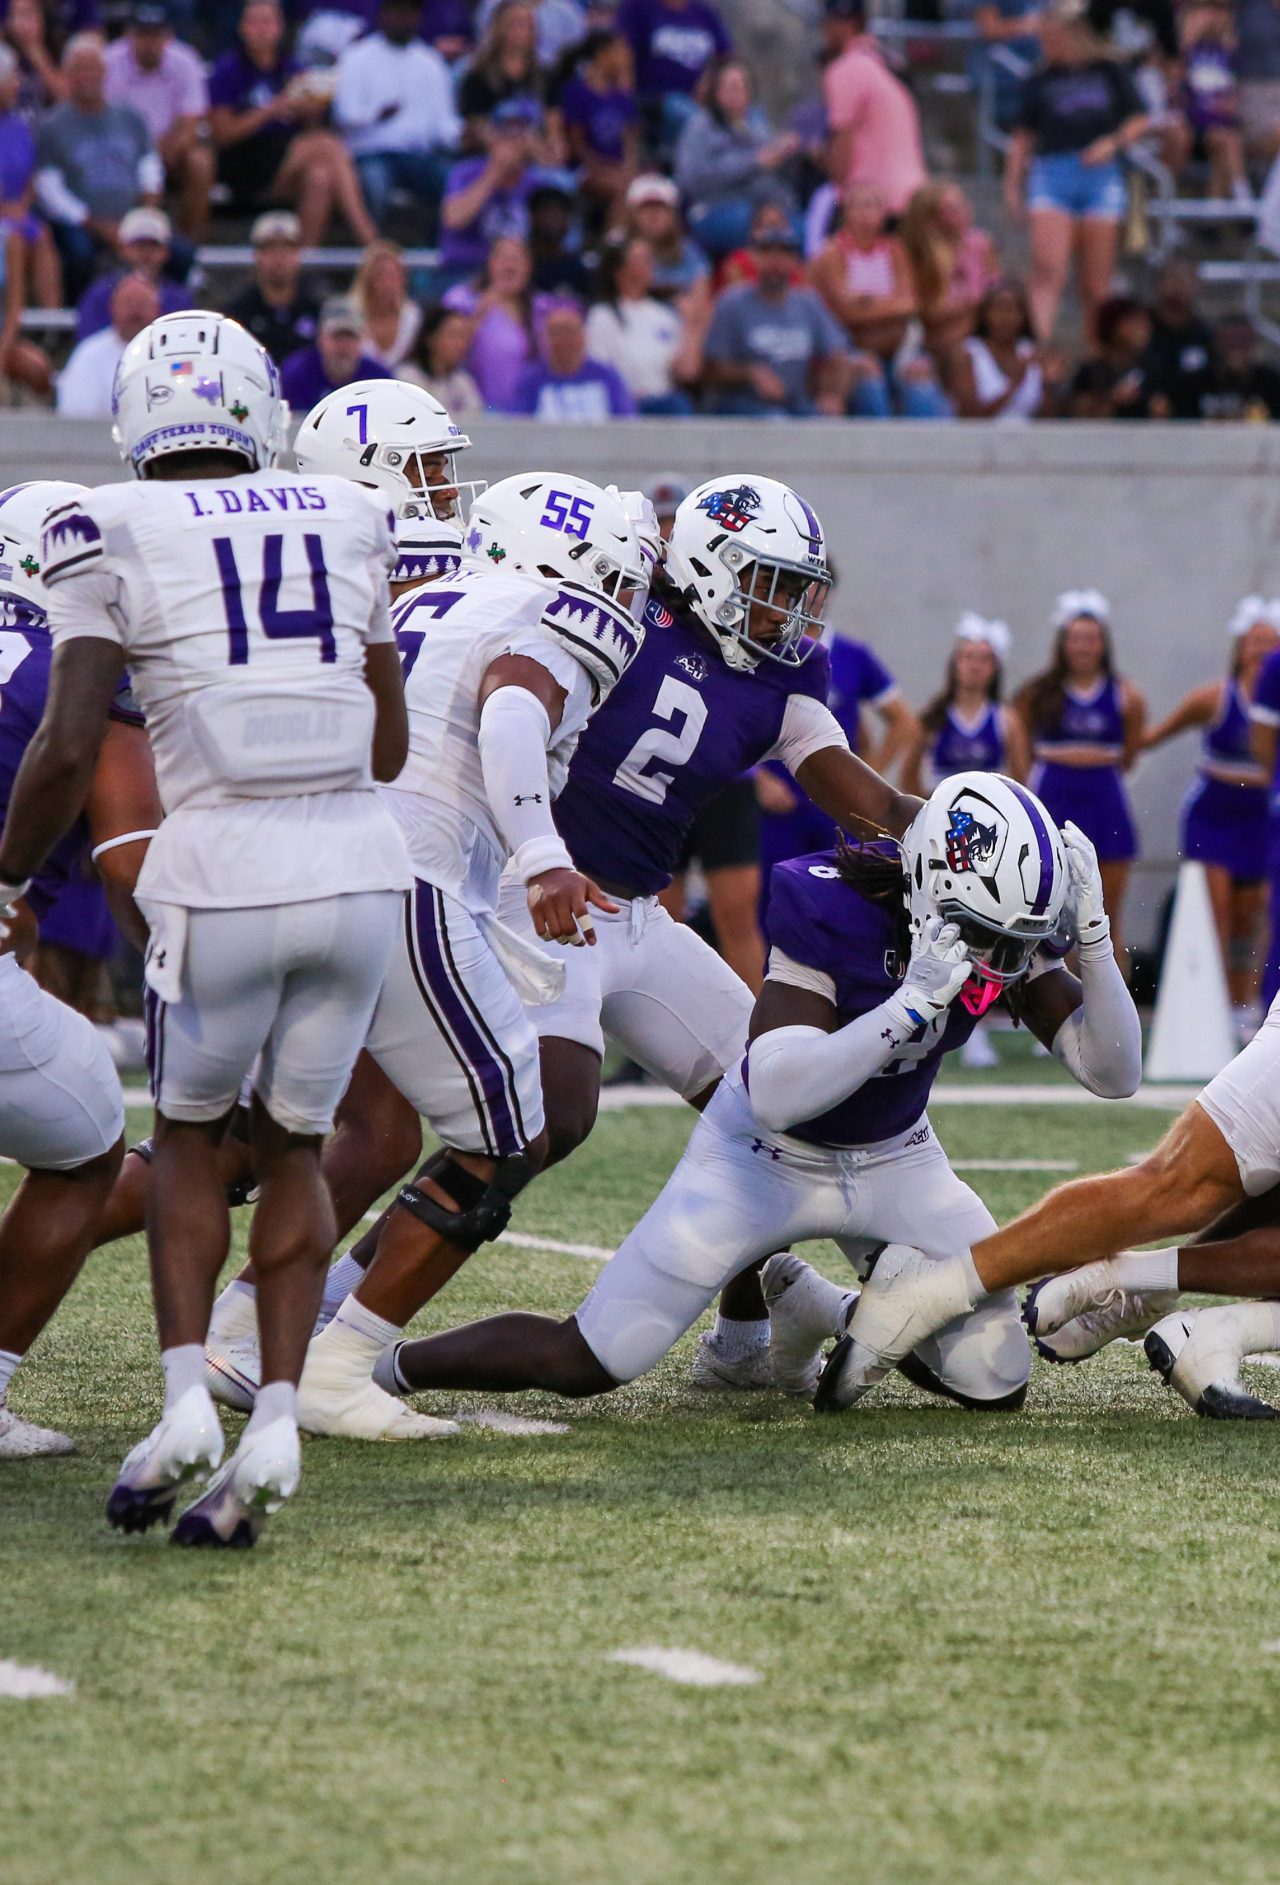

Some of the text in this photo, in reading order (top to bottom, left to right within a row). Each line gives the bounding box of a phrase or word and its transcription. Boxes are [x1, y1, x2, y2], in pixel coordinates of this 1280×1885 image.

[160, 423, 206, 440] TEXAS
[208, 424, 250, 448] TOUGH
[346, 404, 368, 445] 7
[184, 486, 327, 517] I. DAVIS
[539, 489, 596, 541] 55
[211, 533, 338, 666] 14
[242, 708, 343, 748] DOUGLAS
[612, 673, 709, 806] 2
[903, 1124, 930, 1148] ACU
